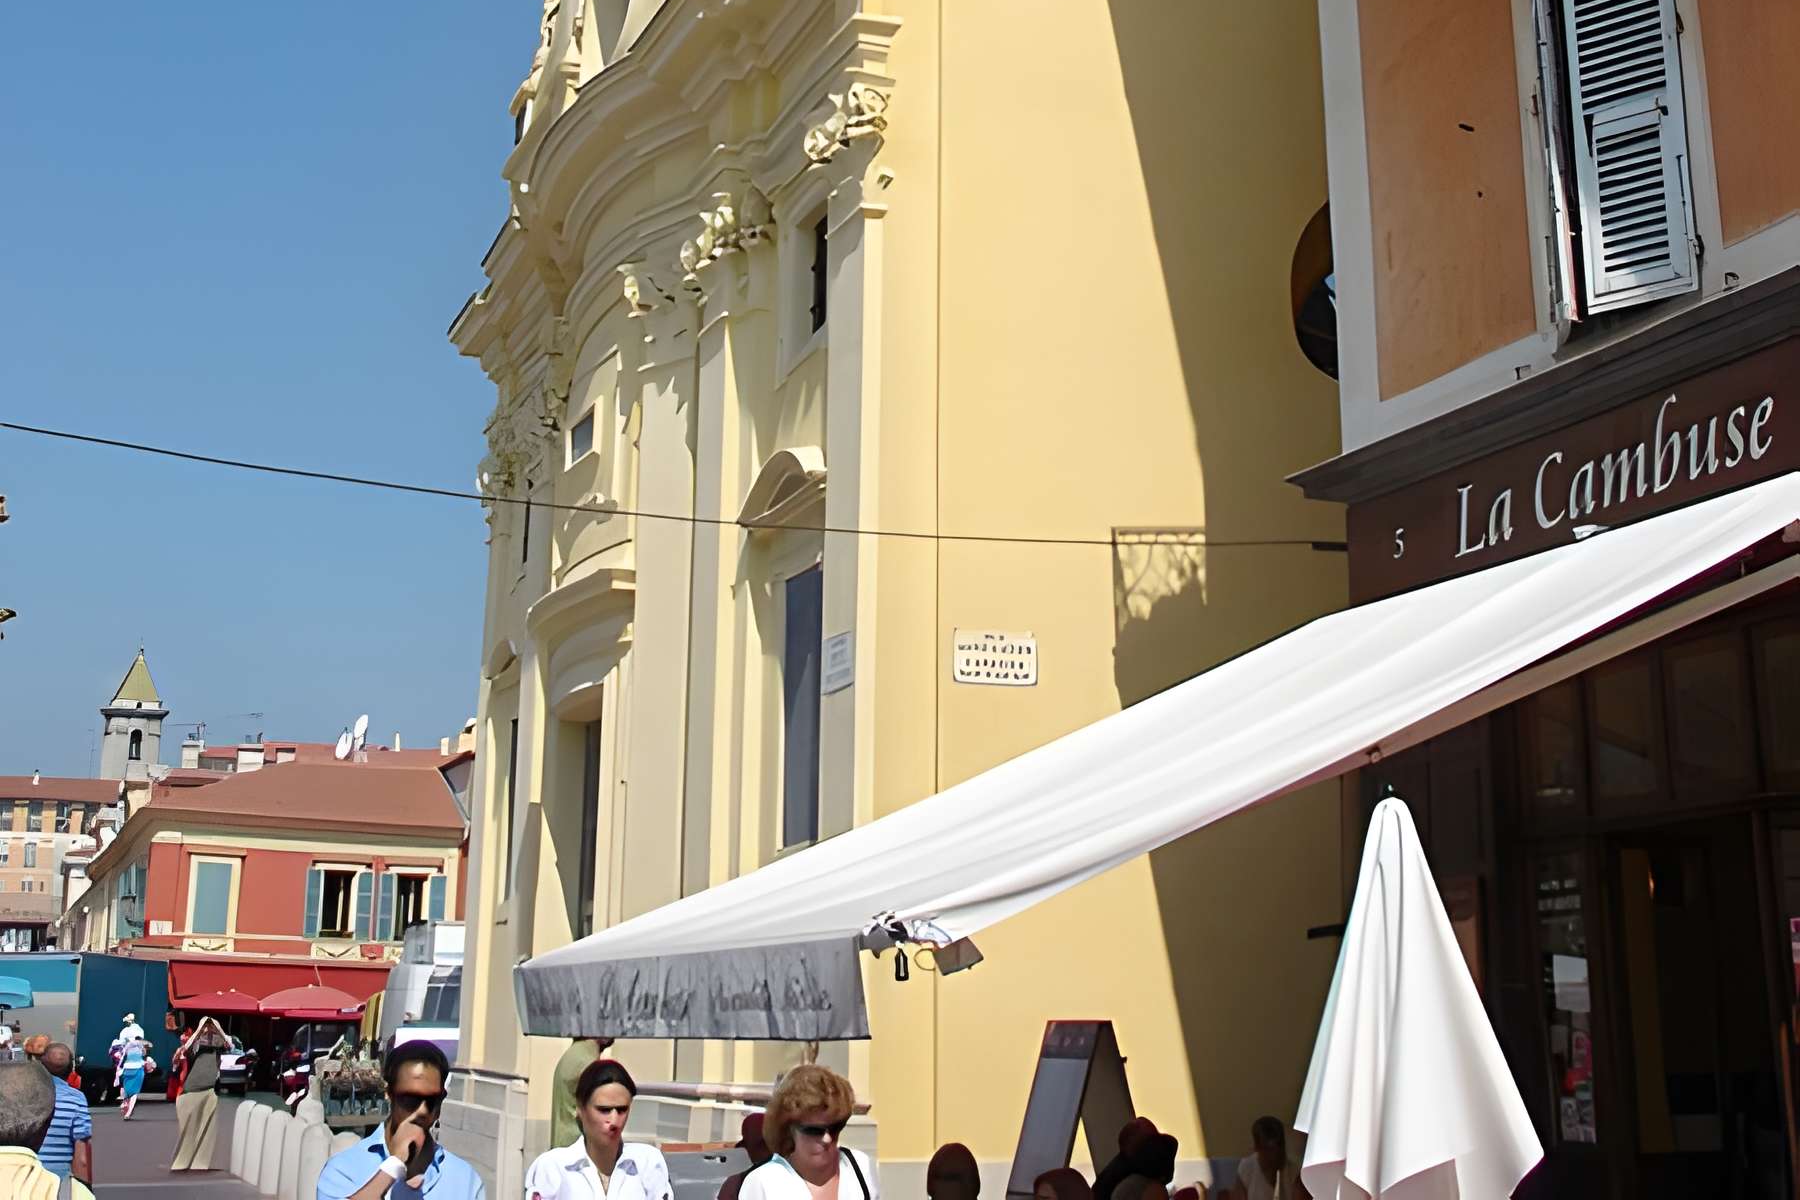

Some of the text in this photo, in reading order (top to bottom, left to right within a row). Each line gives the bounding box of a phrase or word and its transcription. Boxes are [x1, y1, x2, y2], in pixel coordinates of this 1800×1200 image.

[1455, 393, 1774, 558] La Cambuse
[1393, 528, 1404, 559] 5
